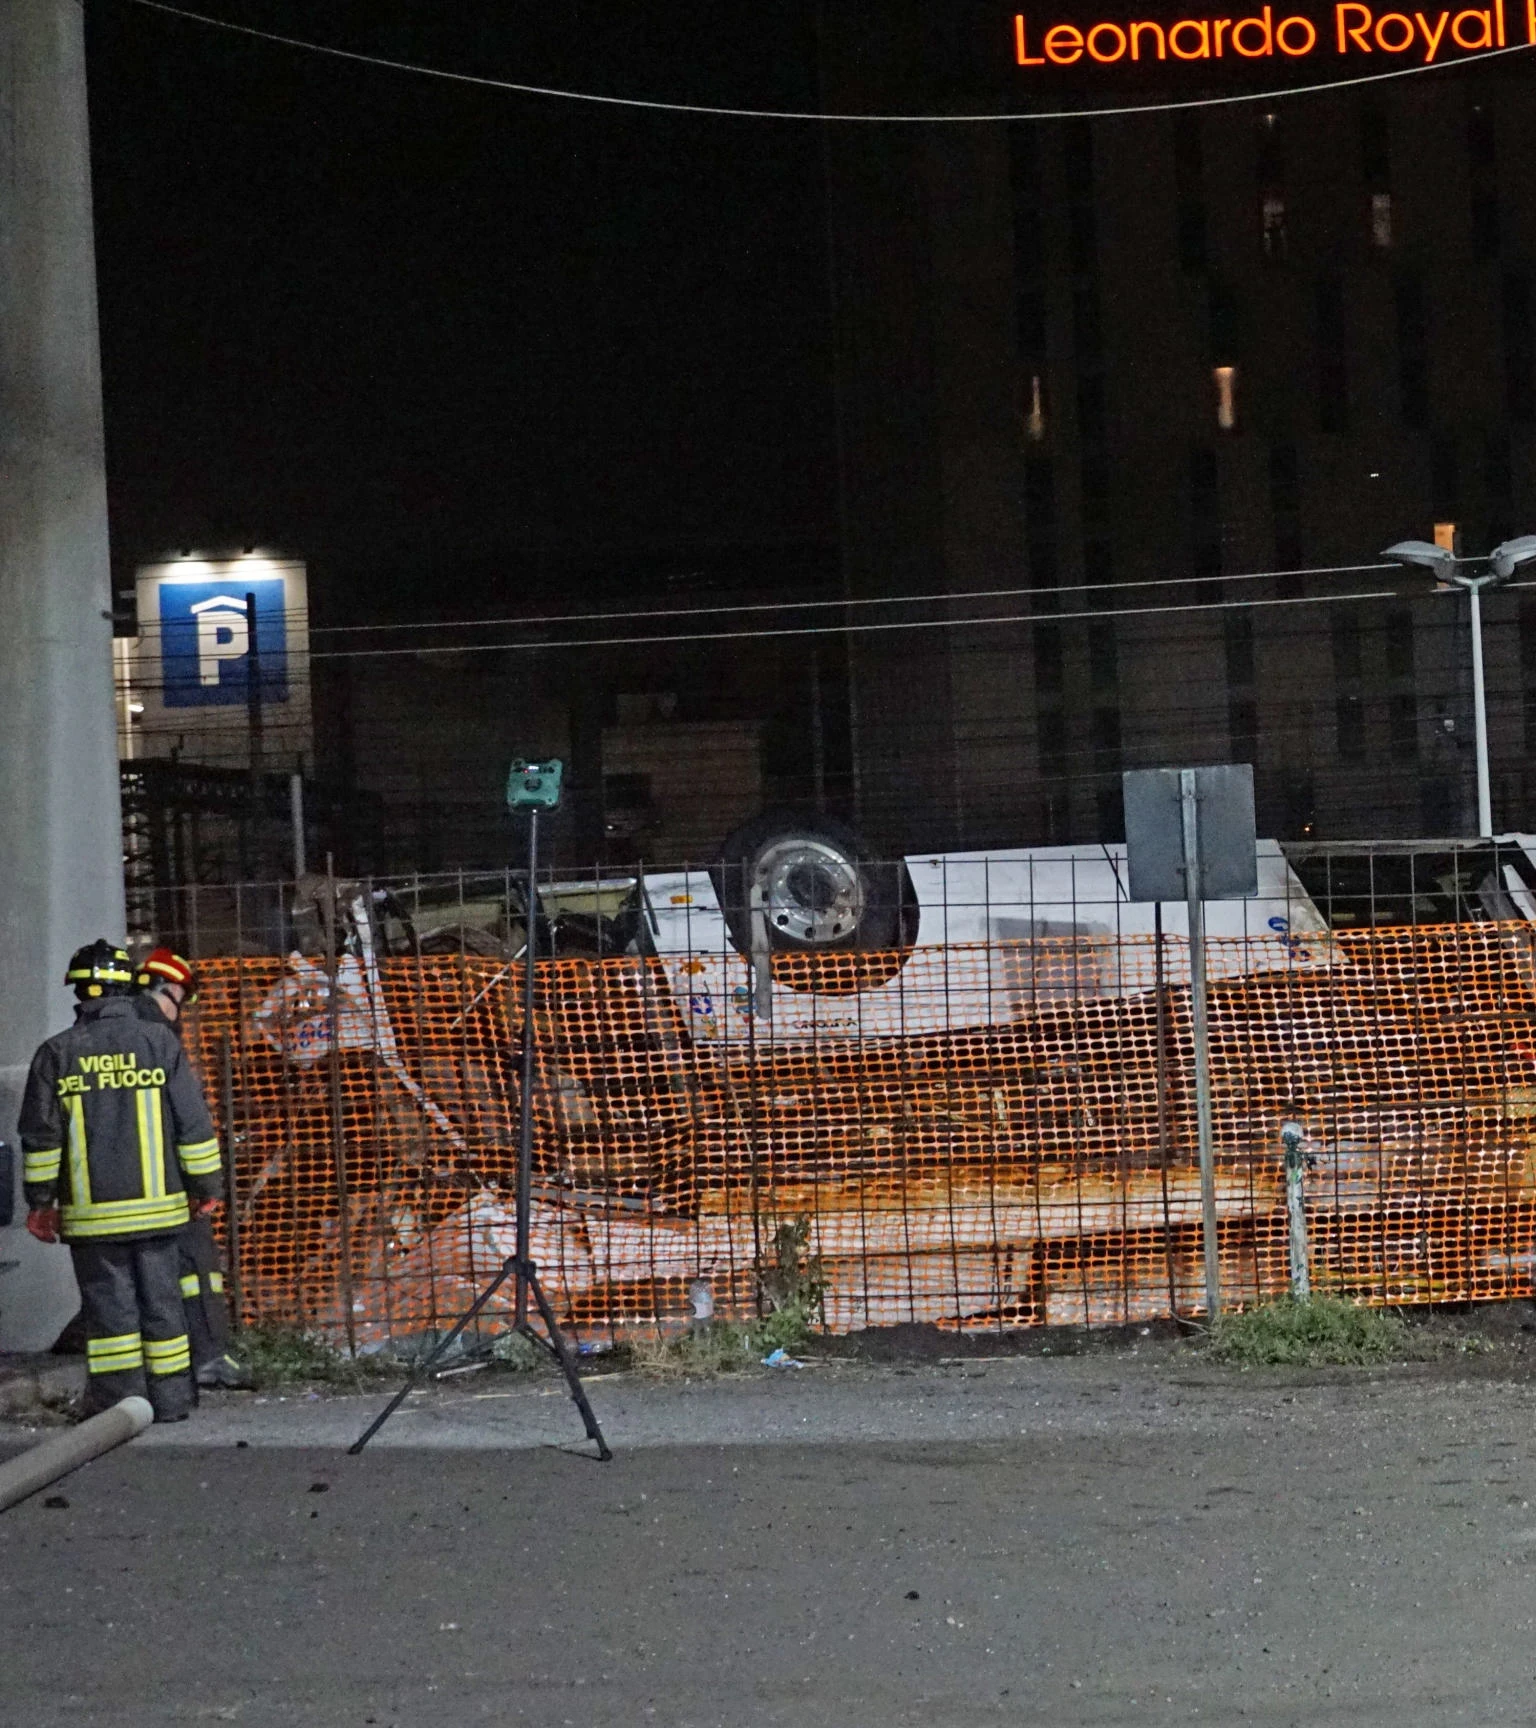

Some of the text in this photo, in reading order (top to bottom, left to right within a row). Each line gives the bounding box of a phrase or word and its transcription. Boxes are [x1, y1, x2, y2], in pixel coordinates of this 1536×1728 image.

[1014, 5, 1317, 66] Leonardo
[1335, 0, 1506, 62] Royal
[198, 610, 250, 686] P
[78, 1052, 137, 1073] VIGILI
[98, 1067, 167, 1089] FUOCO
